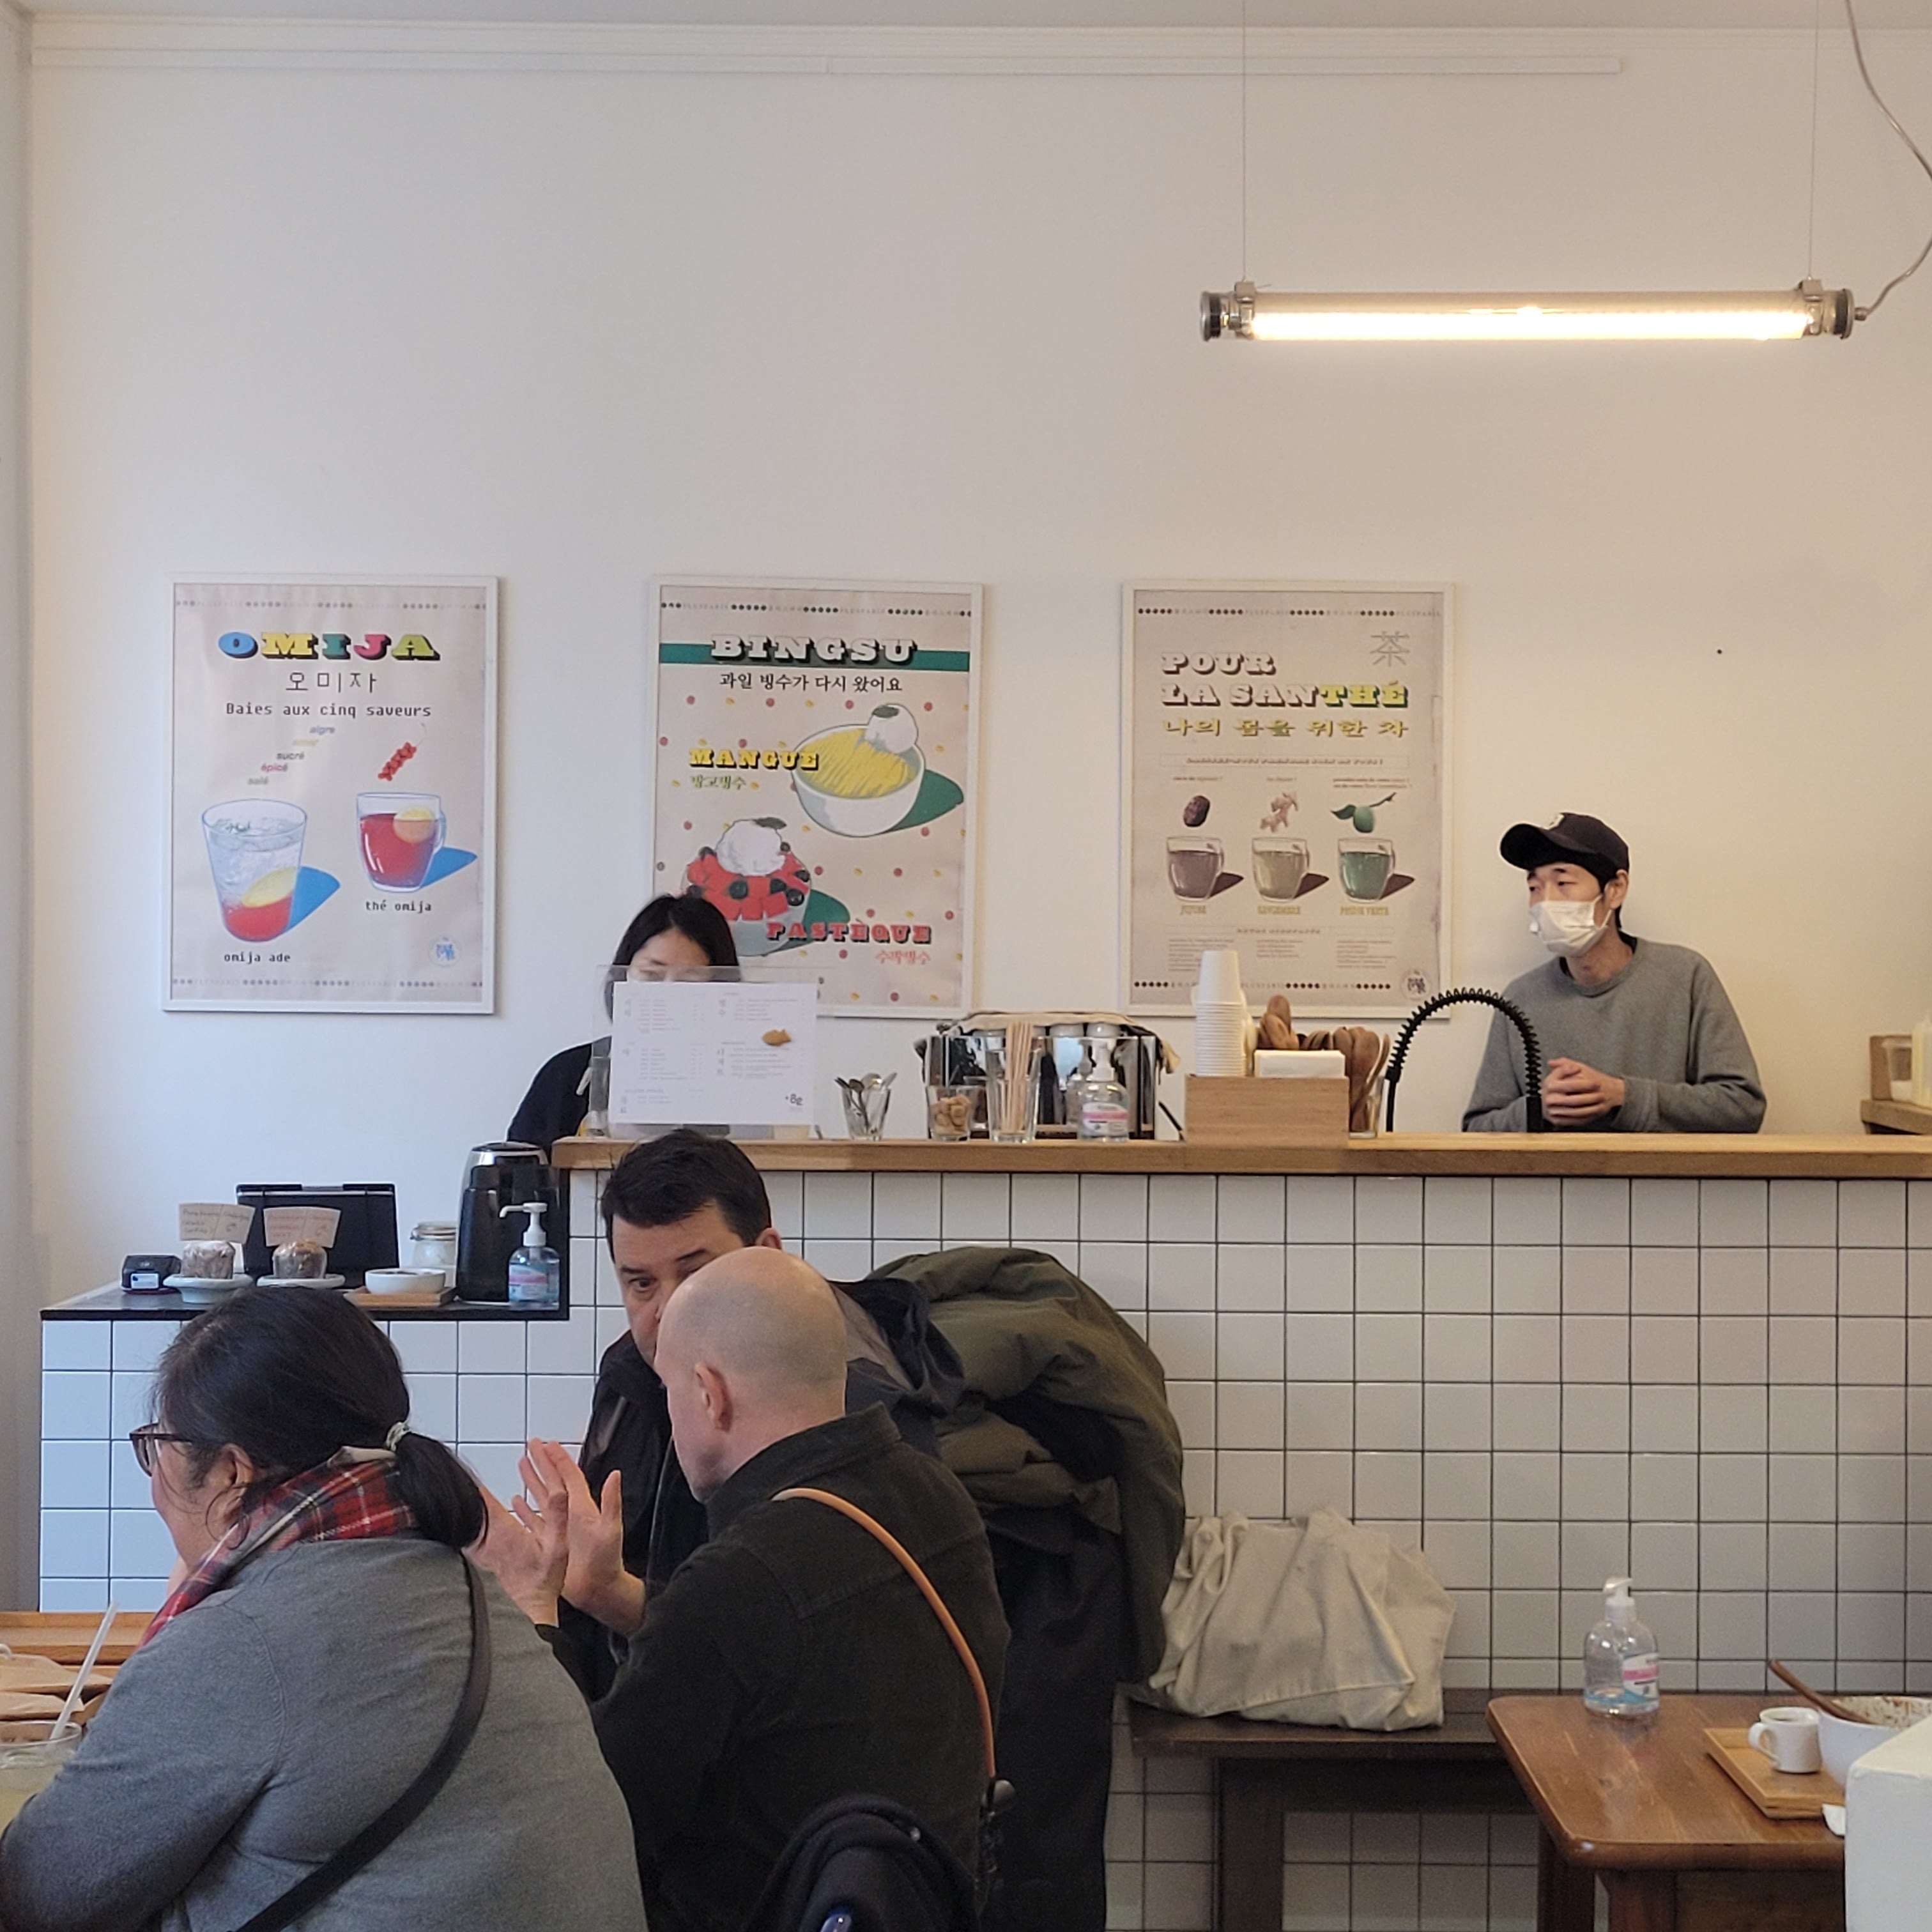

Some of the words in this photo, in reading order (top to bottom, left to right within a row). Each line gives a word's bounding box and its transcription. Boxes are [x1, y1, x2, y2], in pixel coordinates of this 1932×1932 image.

[218, 632, 441, 661] OMIJA
[710, 634, 917, 663] BINGSU
[1161, 652, 1276, 675] POUR
[286, 673, 376, 693] 오미자
[719, 673, 752, 689] 과일
[760, 673, 809, 691] 빙수가
[815, 675, 846, 693] 다시
[853, 677, 903, 692] 왔어요
[1161, 684, 1220, 706] LA
[1230, 680, 1408, 708] SANTHÉ
[226, 702, 272, 715] Baies
[283, 704, 310, 715] aux
[320, 703, 356, 718] cinq
[366, 705, 431, 716] saveurs
[1163, 719, 1220, 736] 나의
[261, 763, 288, 772] épicé
[689, 749, 819, 770] MANGUE
[365, 901, 387, 911] thé
[395, 901, 431, 912] omija
[767, 918, 931, 945] PASTÈQUE
[224, 951, 261, 963] omija
[269, 953, 291, 962] ade
